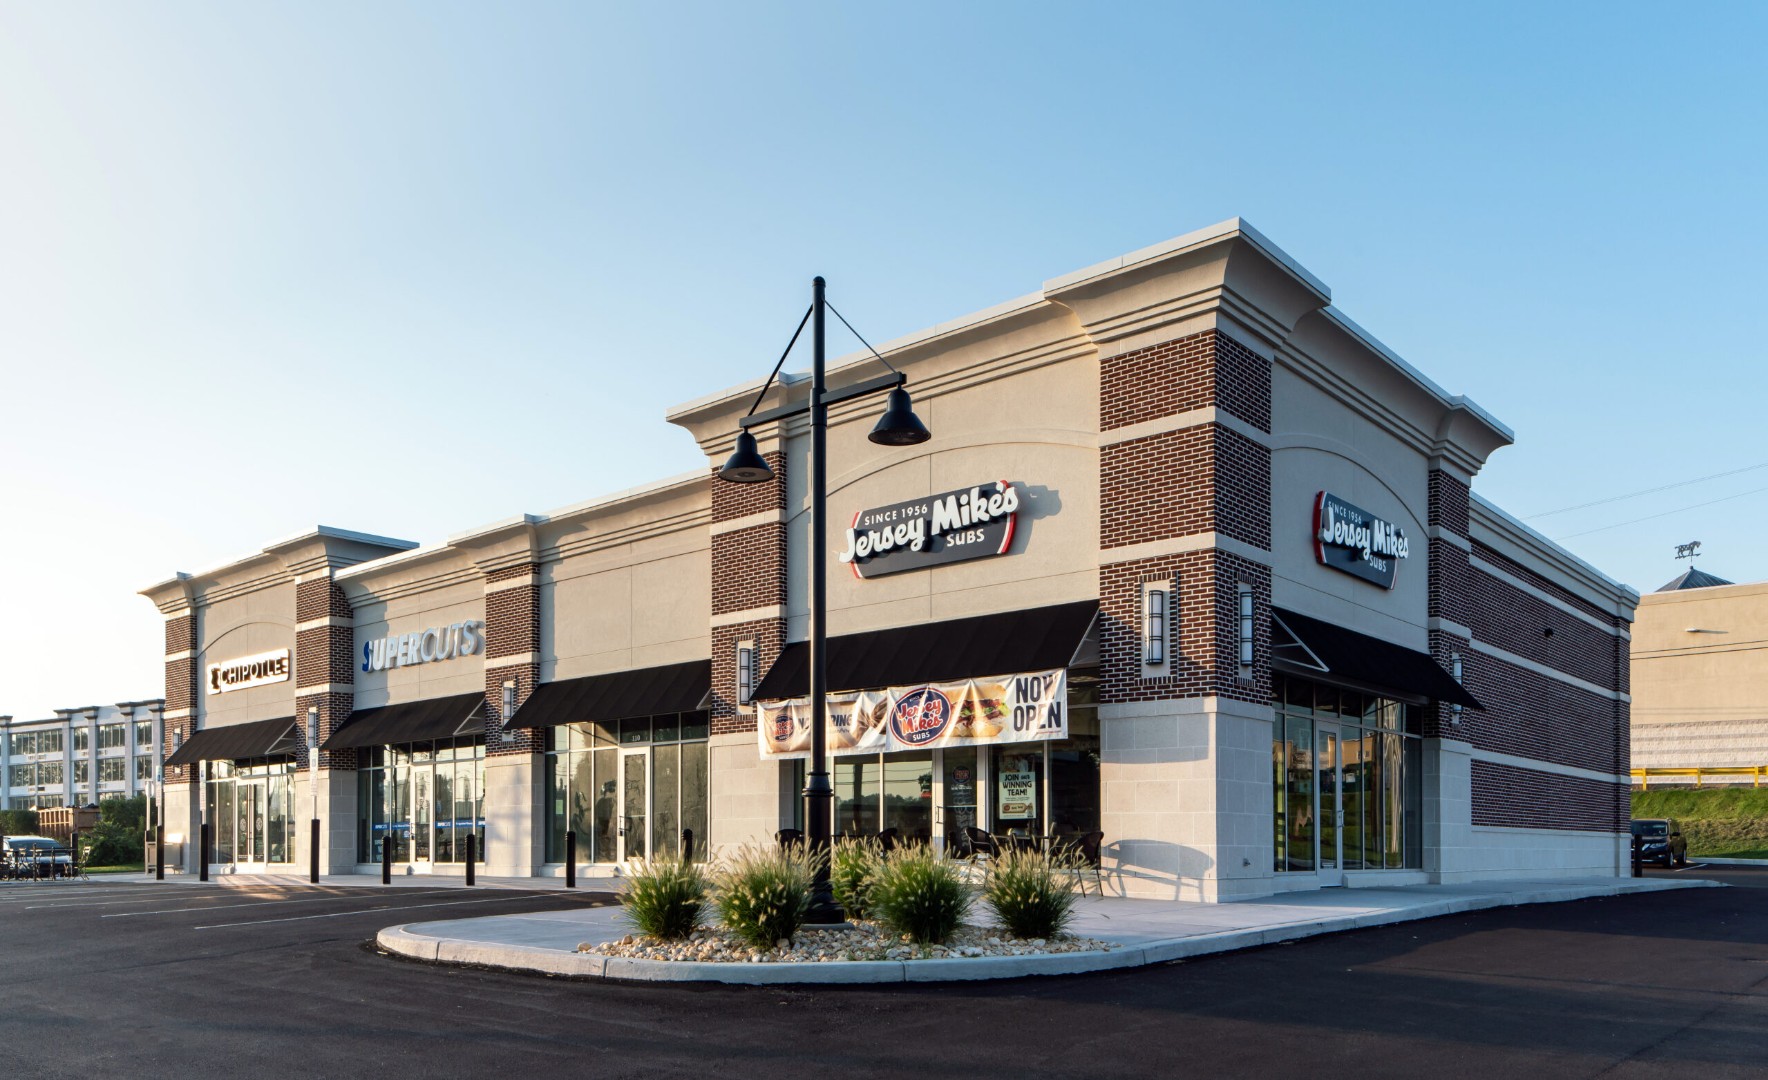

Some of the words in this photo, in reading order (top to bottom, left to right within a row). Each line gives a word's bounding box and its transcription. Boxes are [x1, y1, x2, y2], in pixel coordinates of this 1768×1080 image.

[864, 510, 897, 526] SINCE
[901, 503, 928, 518] 1956
[1328, 500, 1347, 518] SINCE
[838, 516, 926, 563] Jersey
[930, 480, 1019, 536] Mike's
[946, 528, 985, 547] SUBS
[1323, 506, 1371, 561] Jersey
[1373, 519, 1409, 559] Mike's
[1369, 555, 1387, 573] SUBS
[362, 619, 478, 673] SUPERCUTS
[220, 656, 289, 685] CHIPOTLE
[1013, 701, 1062, 732] OPEN
[912, 732, 931, 742] SUBS
[1002, 780, 1033, 789] WINNING
[1004, 773, 1020, 782] JOIN
[1007, 788, 1028, 797] TEAM!
